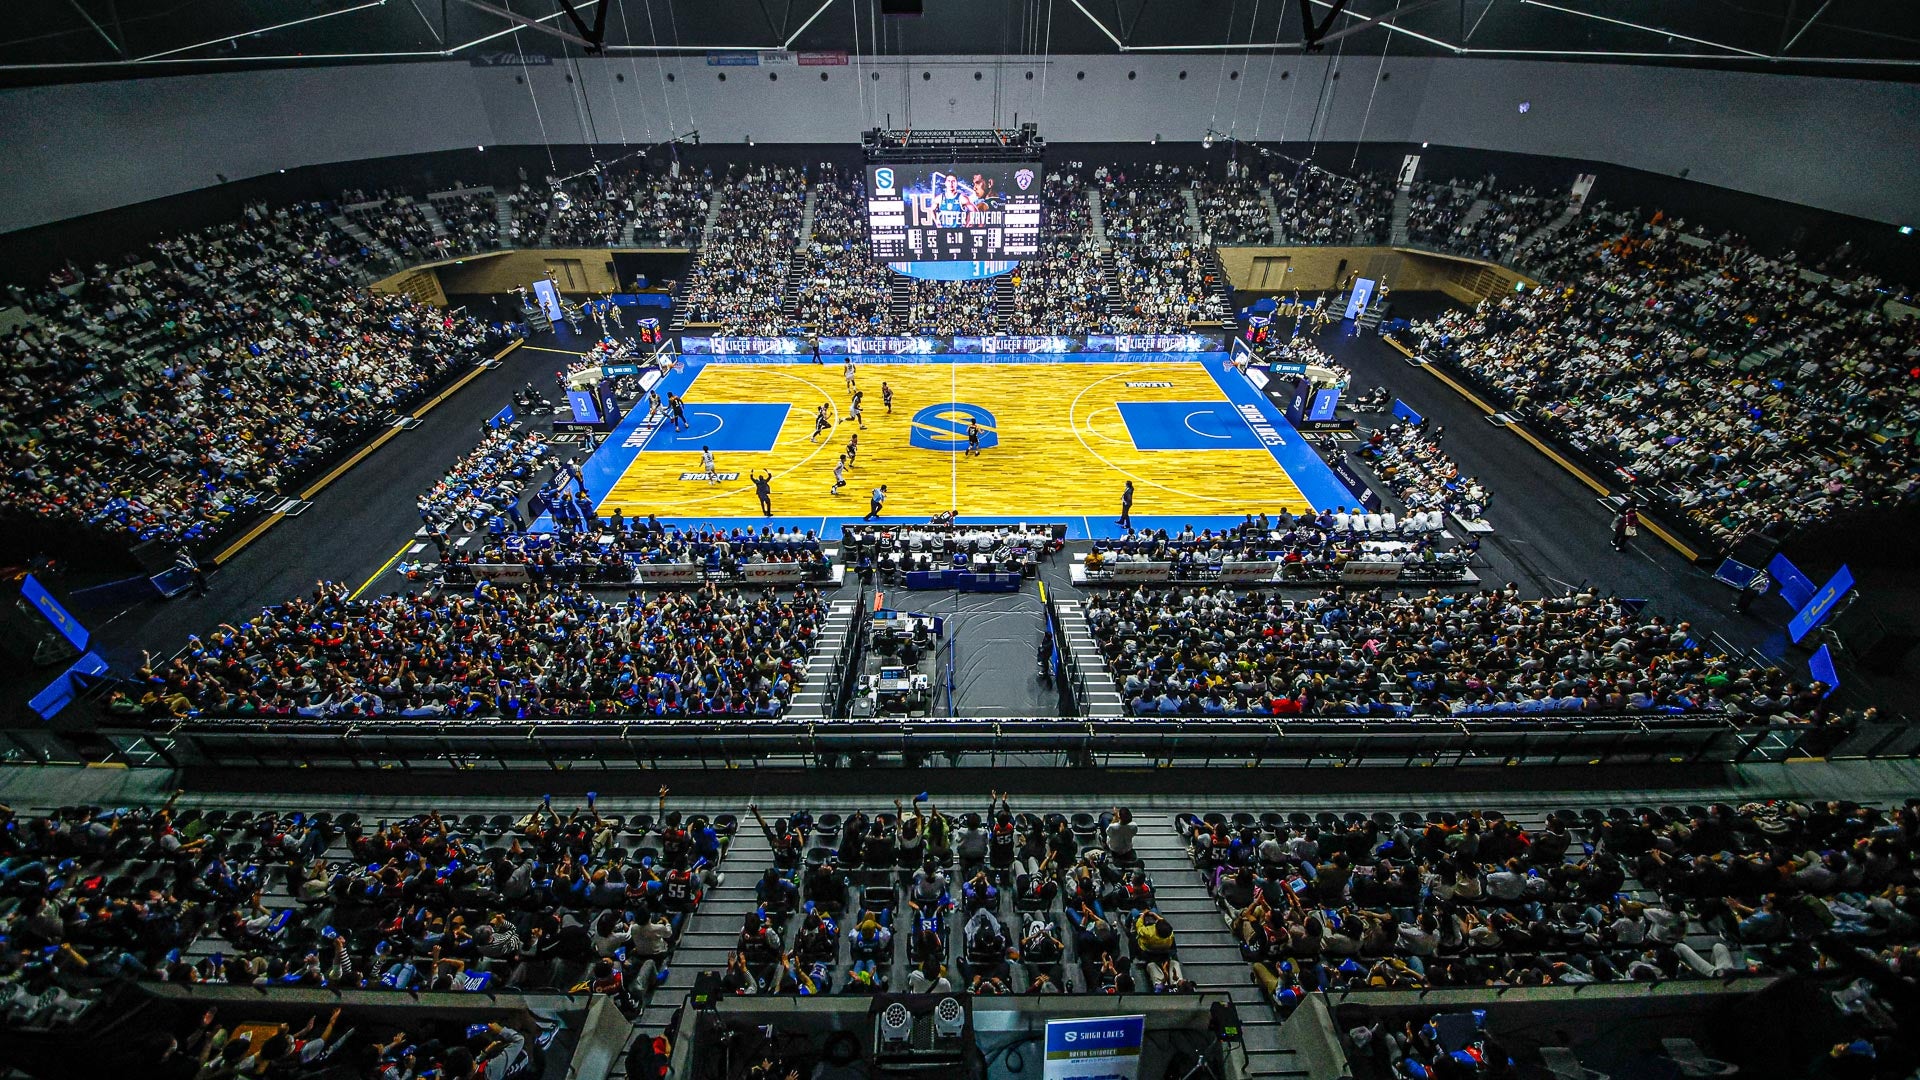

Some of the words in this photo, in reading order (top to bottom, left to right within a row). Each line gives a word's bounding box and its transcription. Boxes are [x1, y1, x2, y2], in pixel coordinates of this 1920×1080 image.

[909, 193, 933, 226] 15
[927, 236, 937, 248] 55
[973, 236, 983, 248] 56
[668, 883, 686, 899] 55
